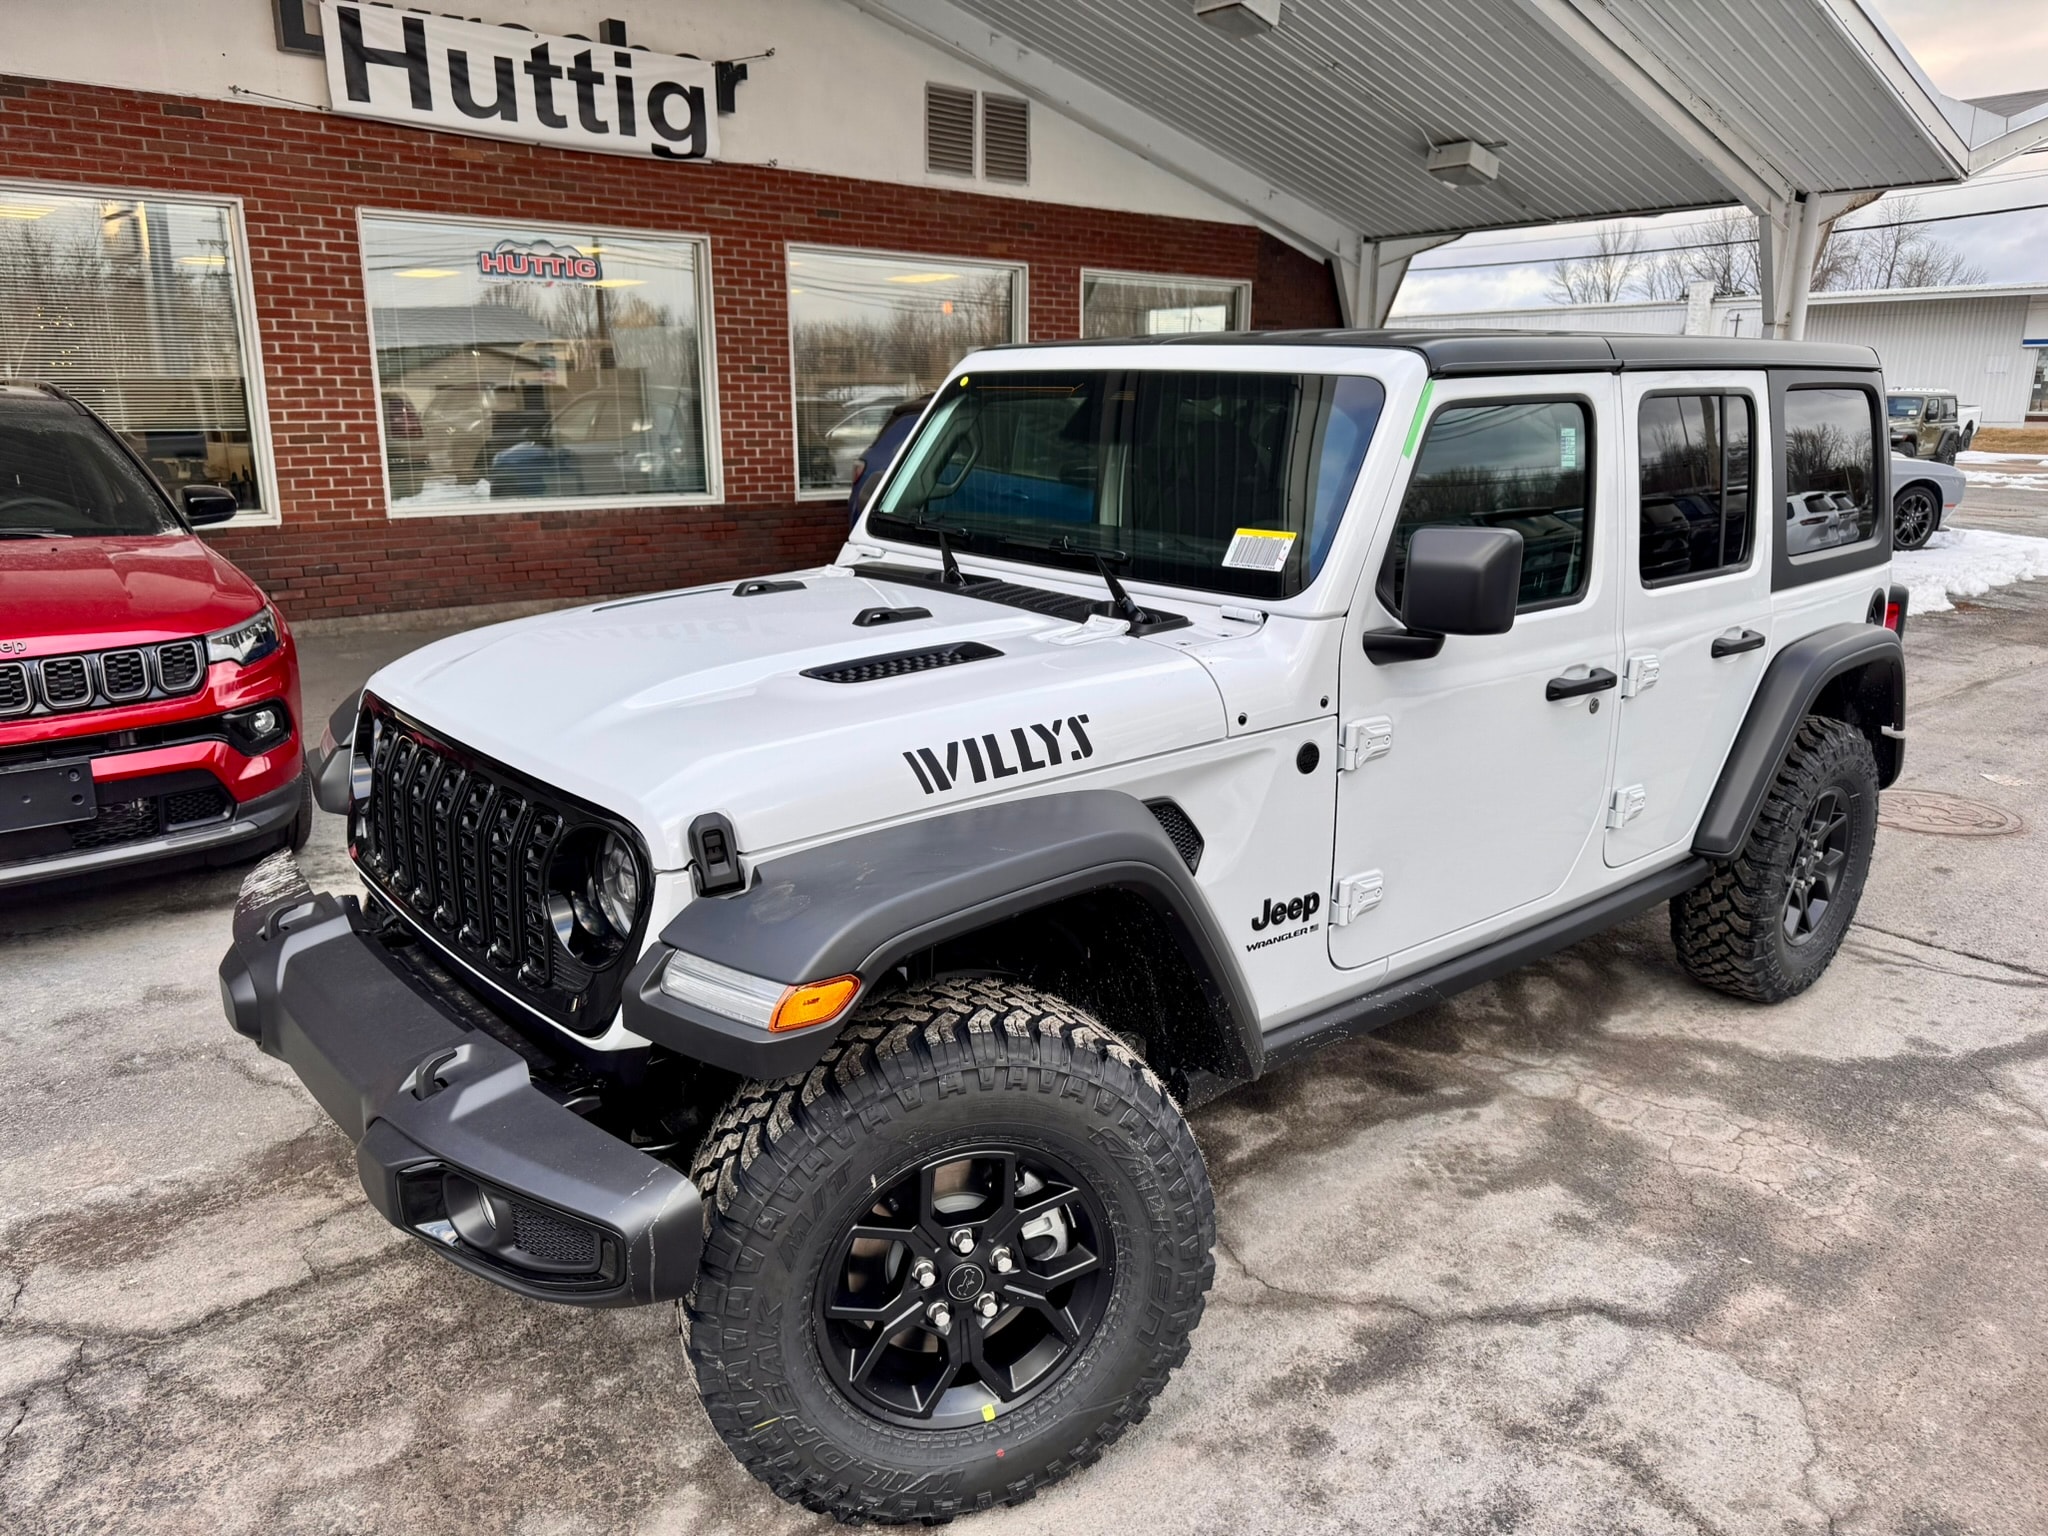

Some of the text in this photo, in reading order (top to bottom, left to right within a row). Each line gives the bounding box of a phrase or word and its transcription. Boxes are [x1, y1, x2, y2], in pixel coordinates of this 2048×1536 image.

[337, 5, 707, 158] Huttig
[480, 253, 598, 279] HUTTIG
[902, 714, 1093, 795] WILLYS
[1246, 926, 1308, 952] WRANGLER
[1251, 891, 1320, 931] Jeep
[777, 1154, 854, 1272] M/T
[1086, 1124, 1176, 1348] FALKEN
[755, 1294, 965, 1494] WILDPEAK
